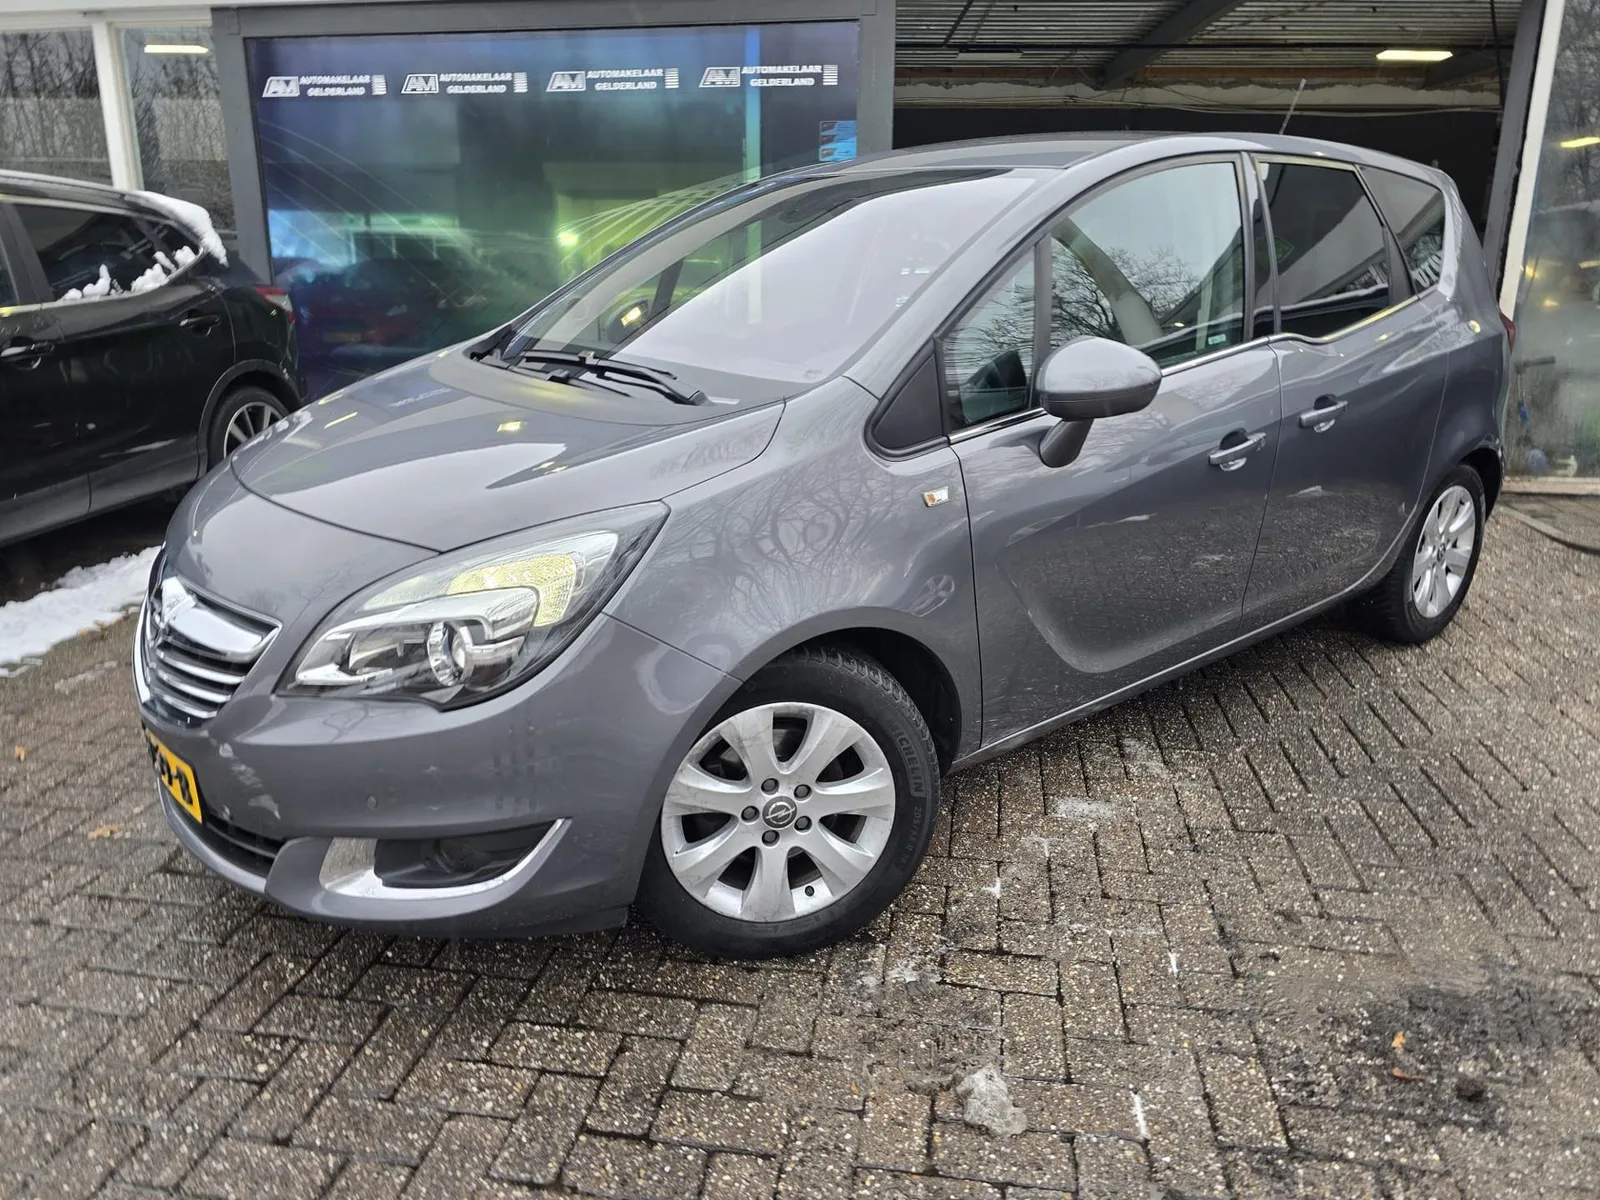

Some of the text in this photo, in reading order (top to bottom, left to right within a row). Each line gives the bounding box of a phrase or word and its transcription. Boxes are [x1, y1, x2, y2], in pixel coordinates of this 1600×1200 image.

[586, 68, 663, 79] AUTOMAKELAAR
[741, 65, 823, 74] AUTOMAKELAAR
[299, 75, 371, 85] AUTOMAKELAAR
[439, 72, 513, 82] AUTOMAKELAAR
[594, 82, 658, 91] GELDERLAND
[749, 78, 815, 87] GELDERLAND
[306, 87, 366, 96] GELDERLAND
[446, 85, 507, 94] GELDERLAND
[887, 718, 926, 794] MICHELIN
